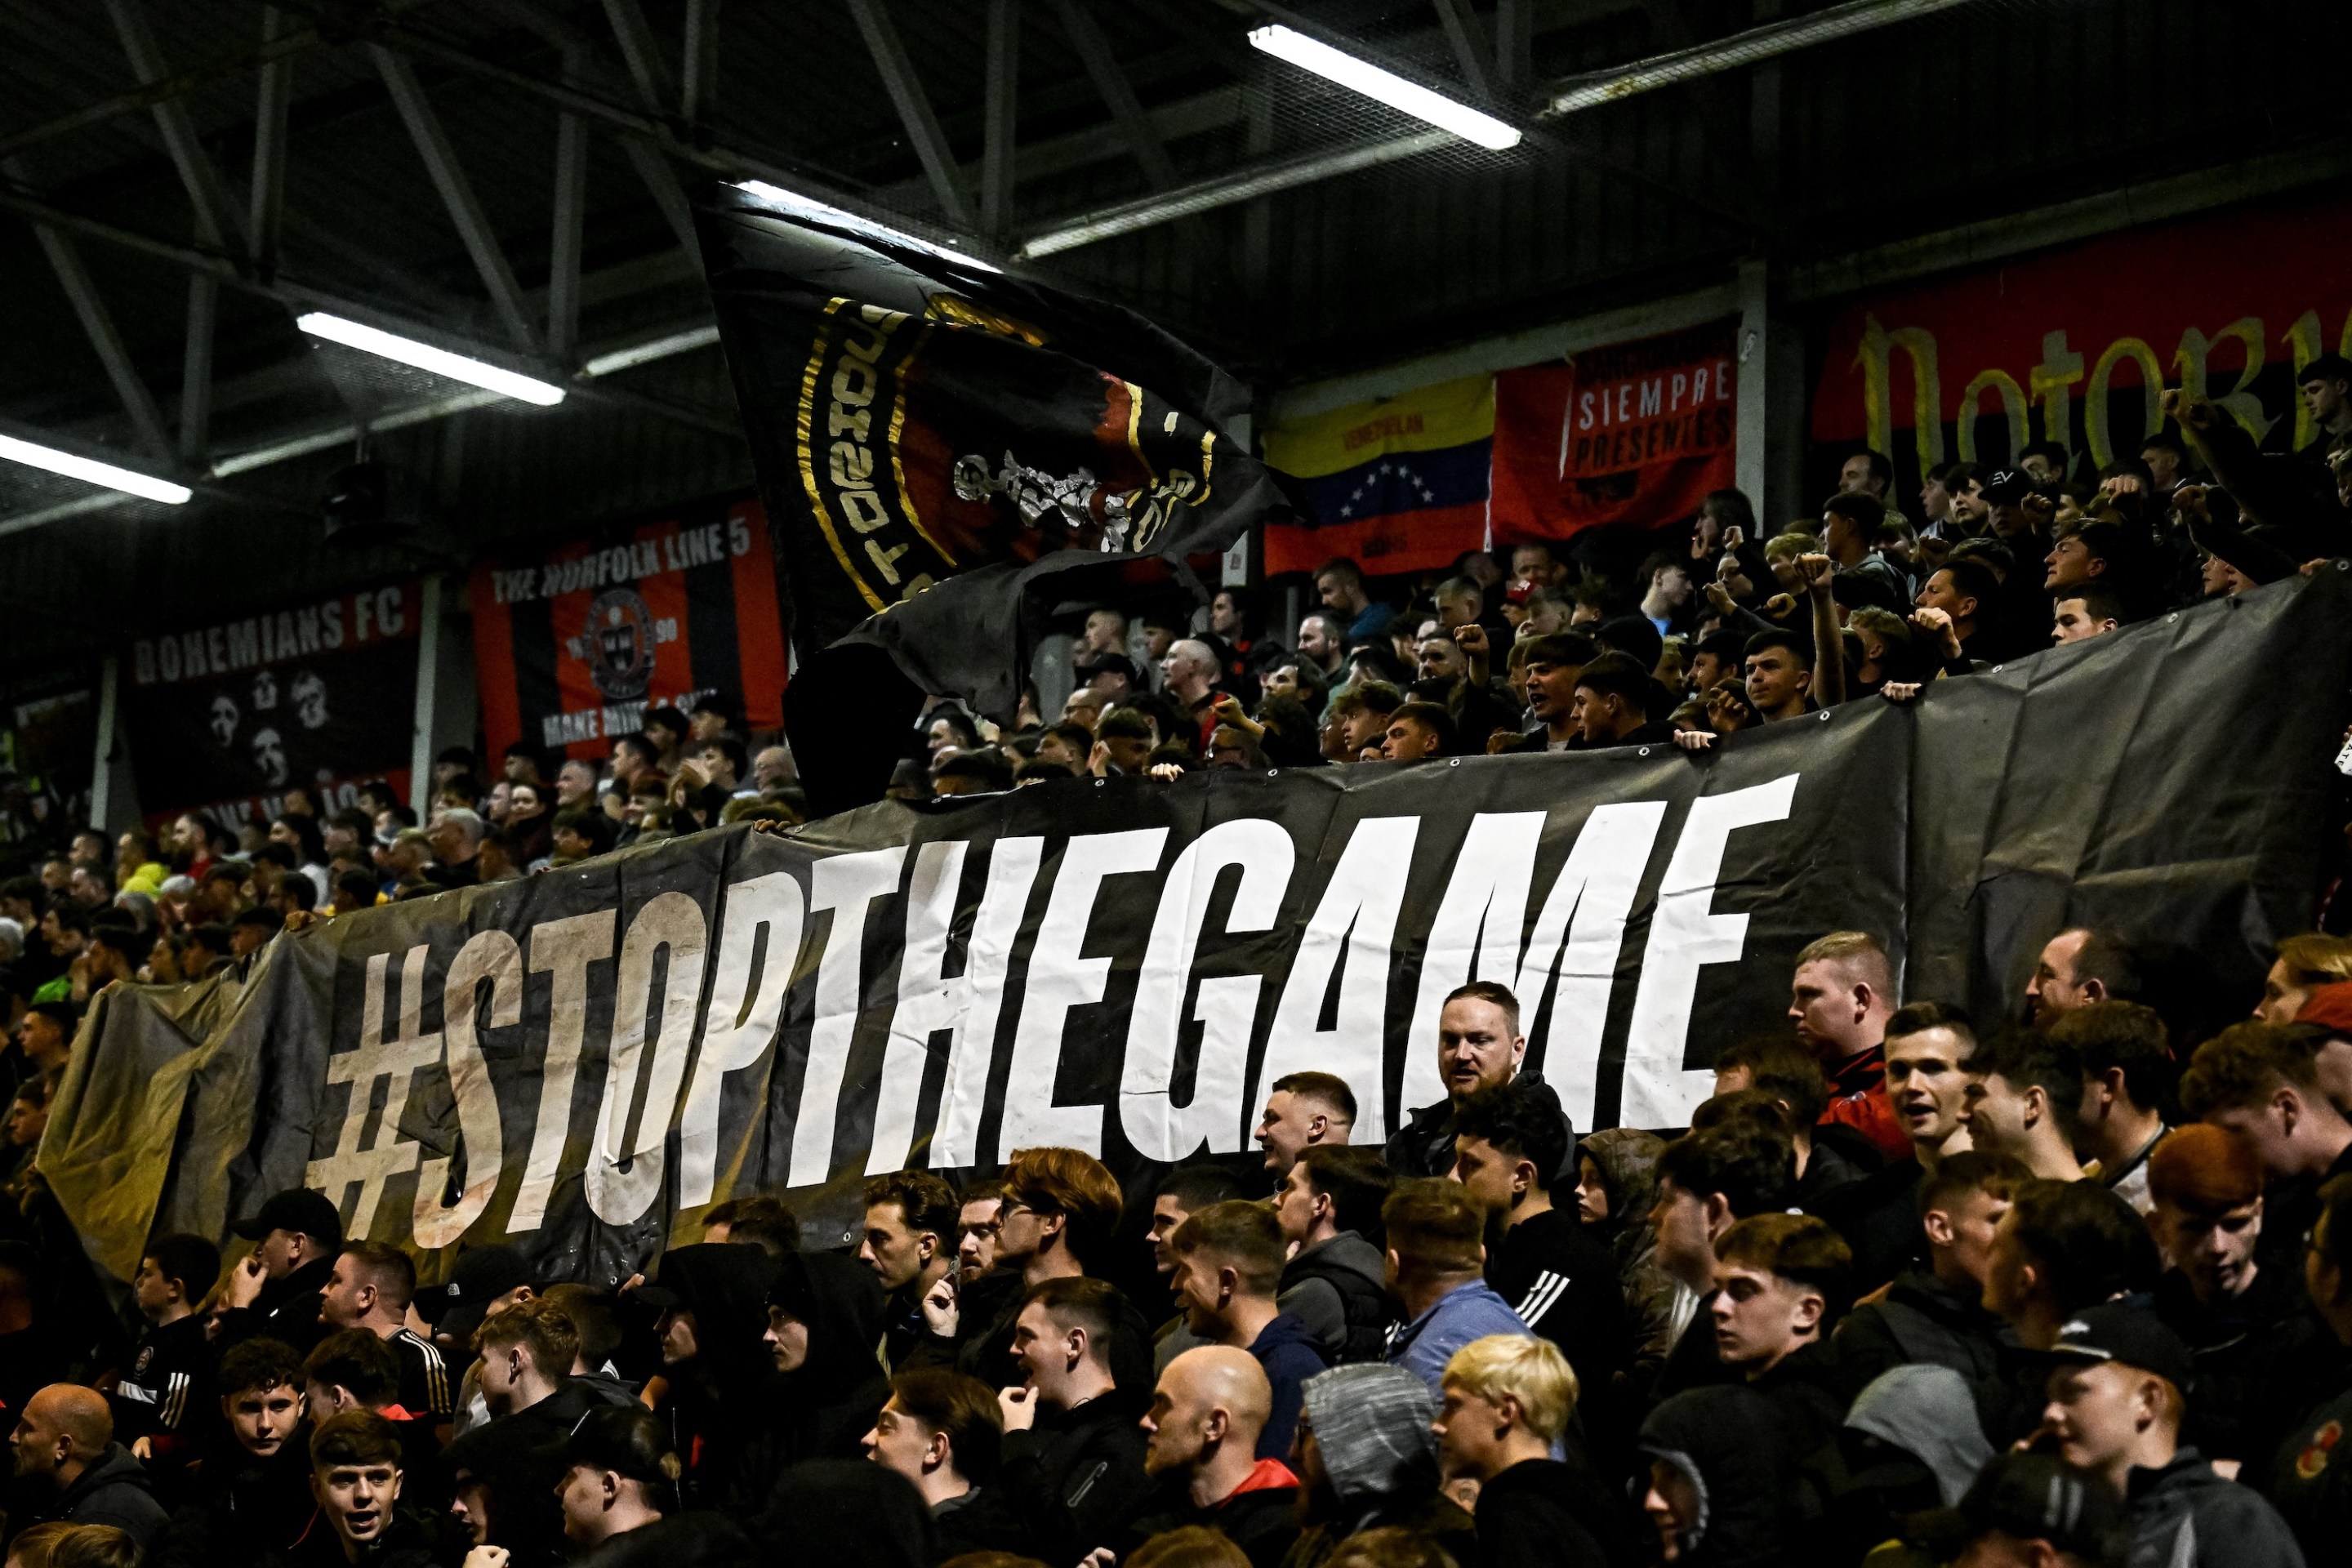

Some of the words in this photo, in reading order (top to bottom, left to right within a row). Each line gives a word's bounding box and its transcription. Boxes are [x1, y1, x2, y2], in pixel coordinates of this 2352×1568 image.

[1574, 406, 1731, 472] PRESENTES
[1578, 362, 1731, 431] SIEMPRE
[491, 568, 539, 604] THE
[540, 542, 661, 598] NORFOLK
[664, 523, 724, 571] LINE
[727, 517, 751, 556] 5
[133, 599, 345, 685] BOHEMIANS
[354, 586, 405, 643] FC
[304, 773, 1800, 1249] #STOPTHEGAME
